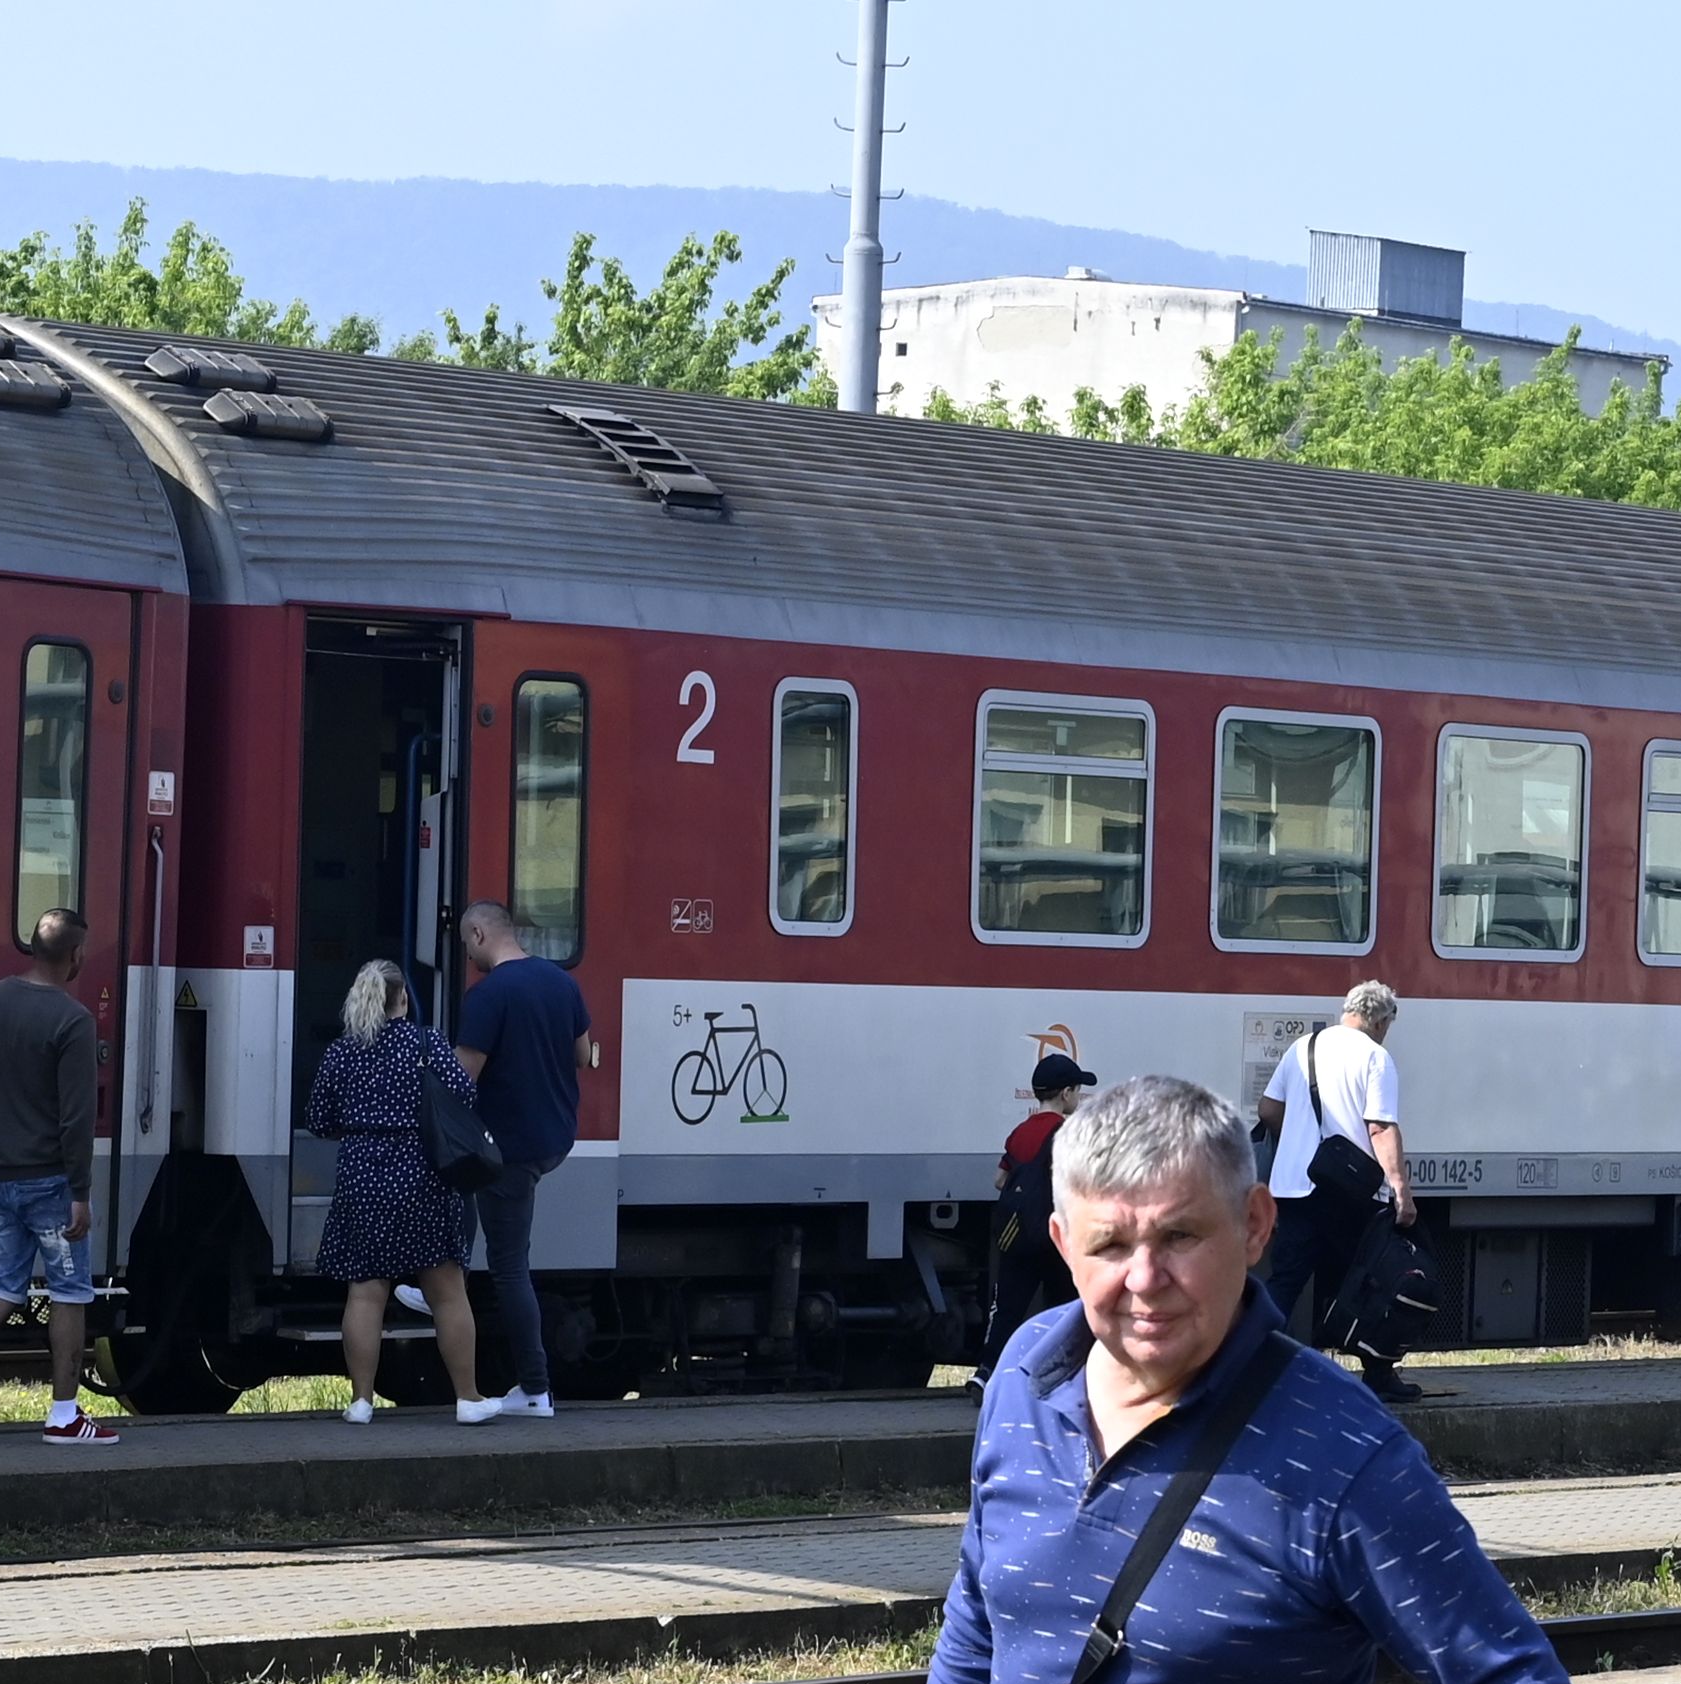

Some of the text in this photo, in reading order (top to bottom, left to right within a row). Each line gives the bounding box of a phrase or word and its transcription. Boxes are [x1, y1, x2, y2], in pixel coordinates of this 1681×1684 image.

[676, 670, 716, 765] 2
[672, 1004, 693, 1027] 5+
[1441, 1159, 1483, 1184] 142-5
[1518, 1161, 1537, 1184] 120
